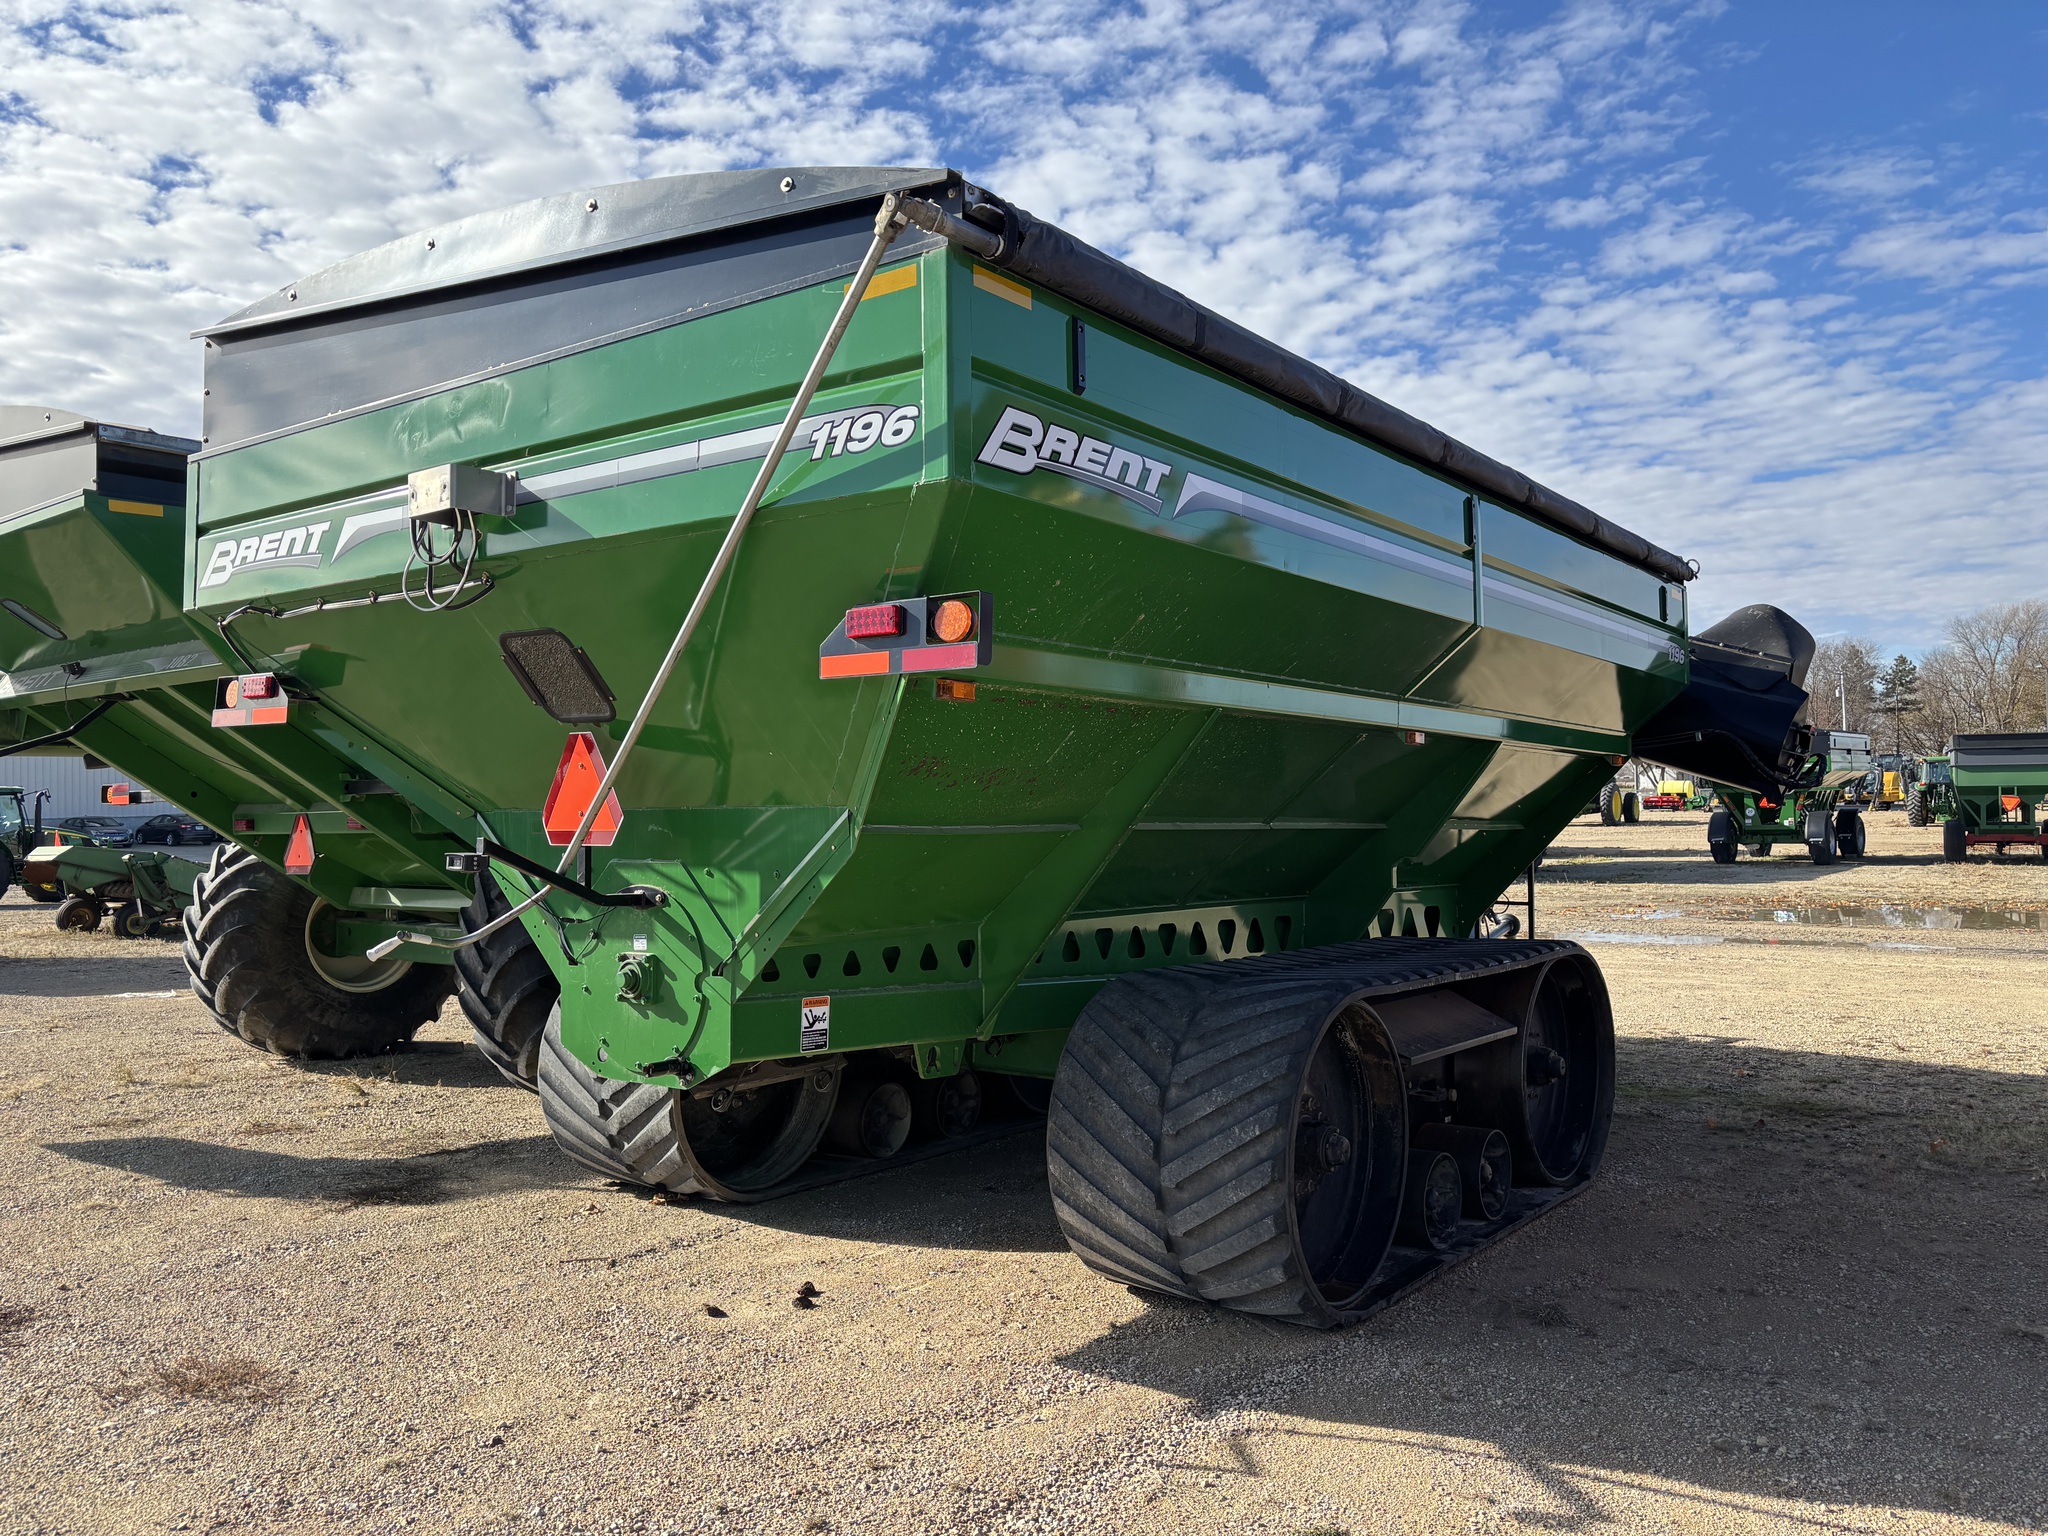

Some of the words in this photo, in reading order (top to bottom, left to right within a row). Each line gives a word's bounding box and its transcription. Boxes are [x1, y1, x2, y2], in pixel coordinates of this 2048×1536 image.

[810, 404, 920, 462] 1196
[974, 404, 1172, 498] BRENT
[199, 520, 333, 590] BRENT
[1668, 644, 1686, 665] 1196
